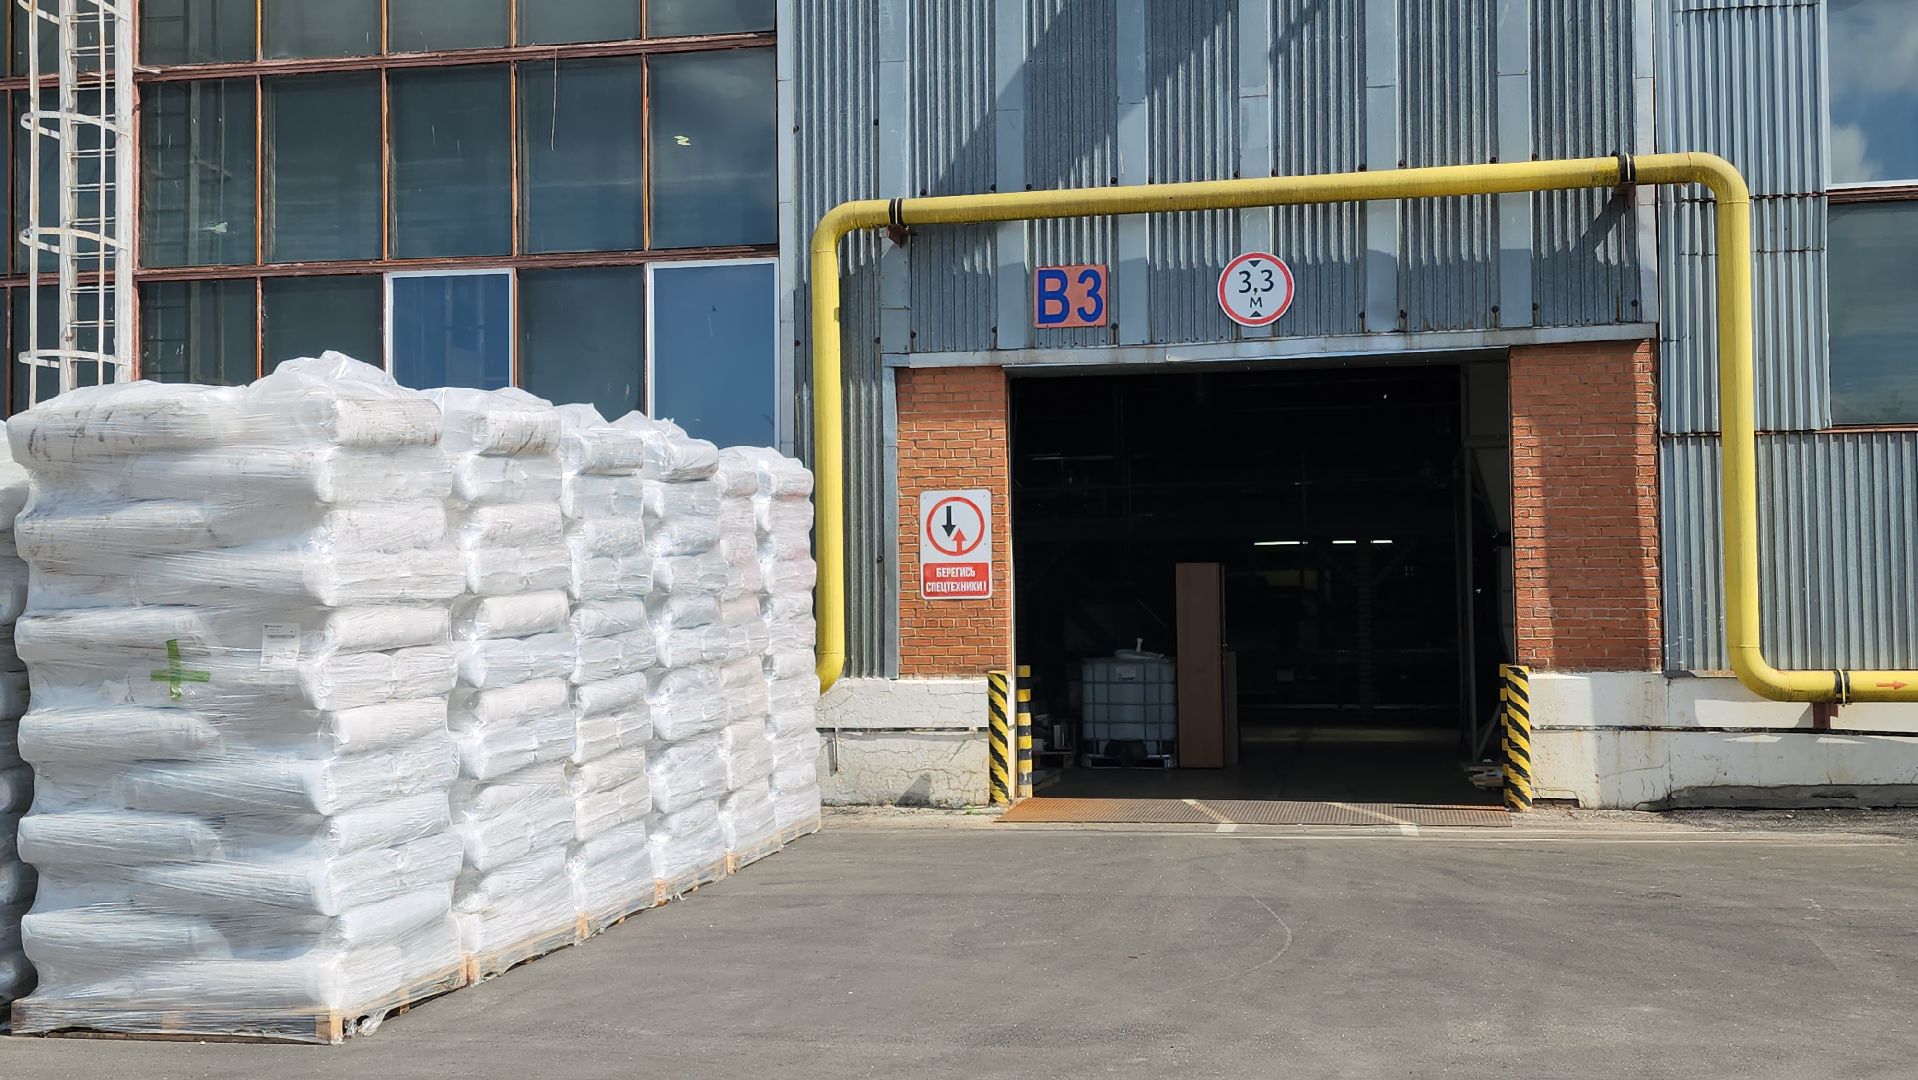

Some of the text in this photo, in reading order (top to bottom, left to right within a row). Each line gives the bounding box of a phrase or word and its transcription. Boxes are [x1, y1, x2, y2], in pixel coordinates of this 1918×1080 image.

[1239, 269, 1274, 295] 3,3
[936, 567, 976, 577] БЕРЕГИСЬ
[926, 581, 986, 593] СПЕЦТЕХНИКИ!
